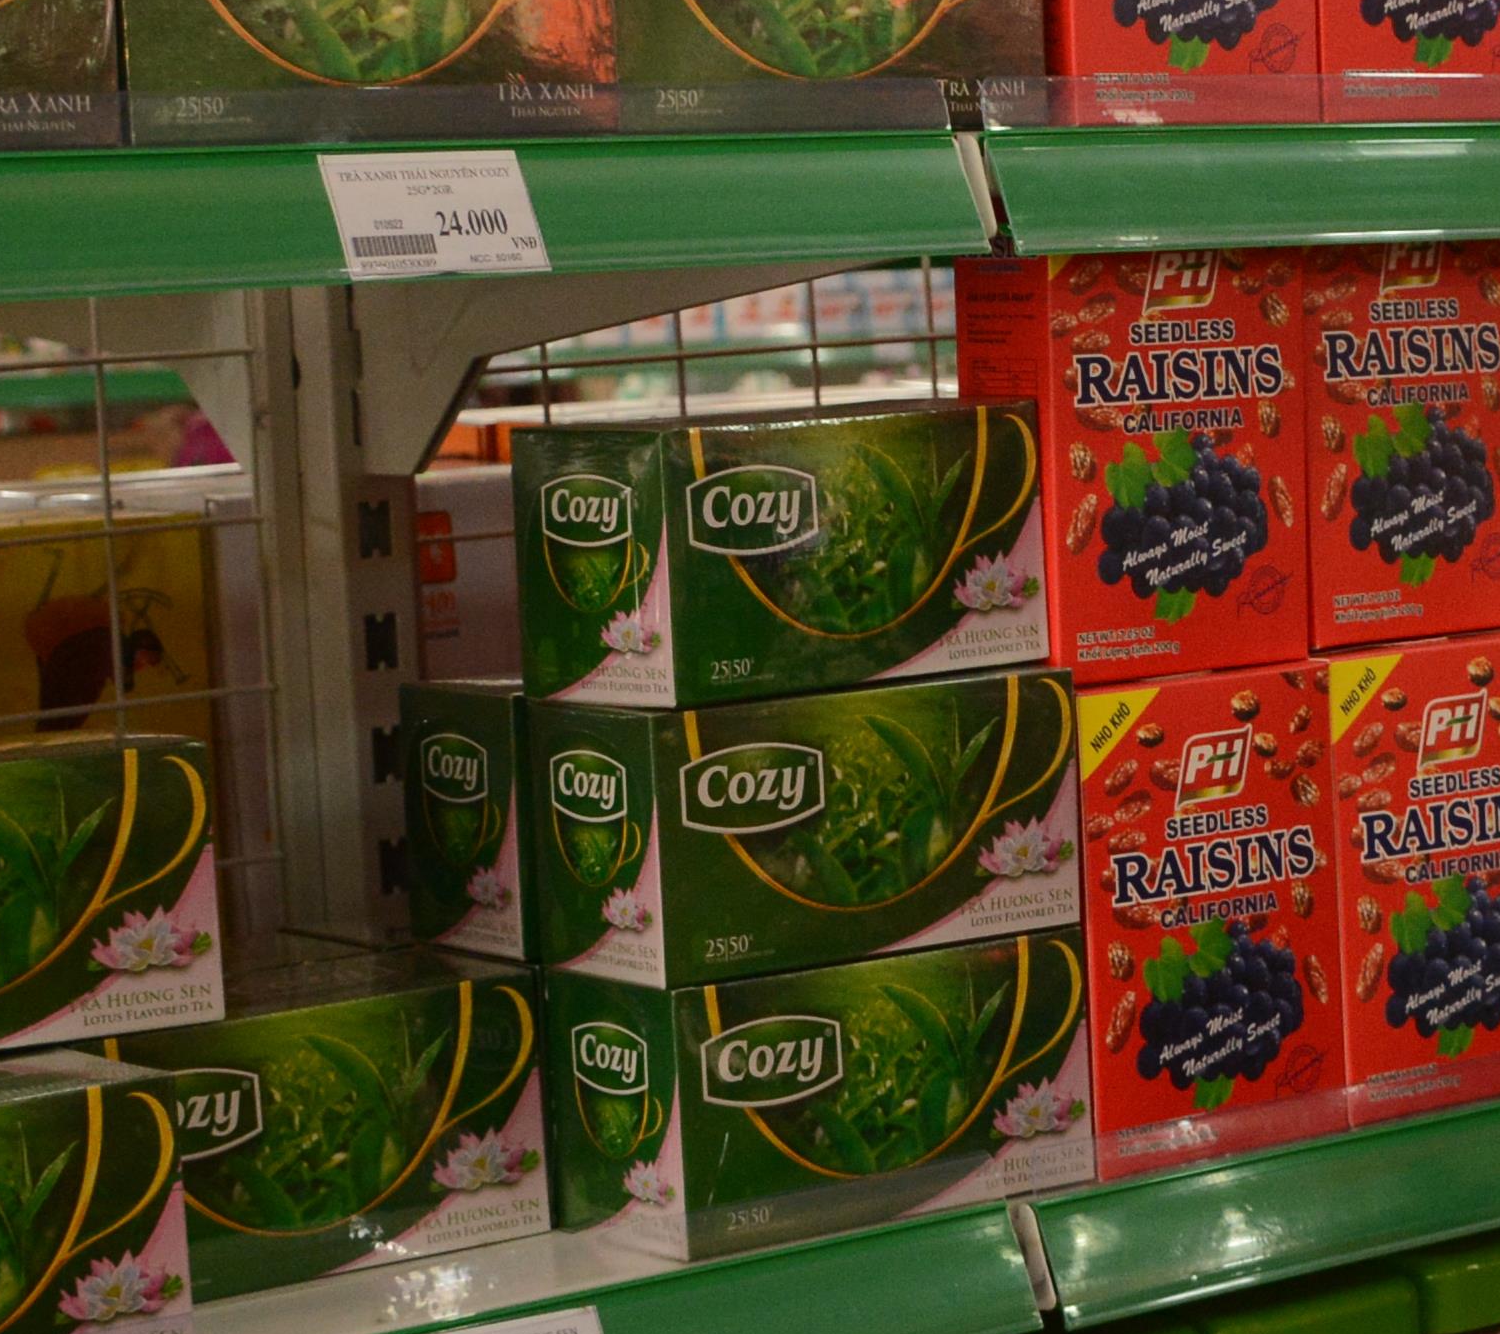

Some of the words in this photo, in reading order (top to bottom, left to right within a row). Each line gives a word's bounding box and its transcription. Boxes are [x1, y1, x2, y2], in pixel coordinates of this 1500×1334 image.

[435, 208, 508, 236] 24.000
[1130, 319, 1234, 345] SEEDLESS
[1322, 321, 1500, 382] RAISINS
[1074, 345, 1283, 407] RAISINS
[1123, 407, 1243, 434] CALIFORNIA
[551, 488, 619, 531] Cozy
[702, 484, 801, 534] Cozy
[559, 766, 616, 806] Cozy
[698, 763, 806, 812] Cozy
[1166, 805, 1267, 840] SEEDLESS
[1111, 826, 1316, 906] RAISINS
[1160, 892, 1277, 928] CALIFORNIA
[718, 1034, 823, 1084] Cozy
[176, 1090, 240, 1136] zy
